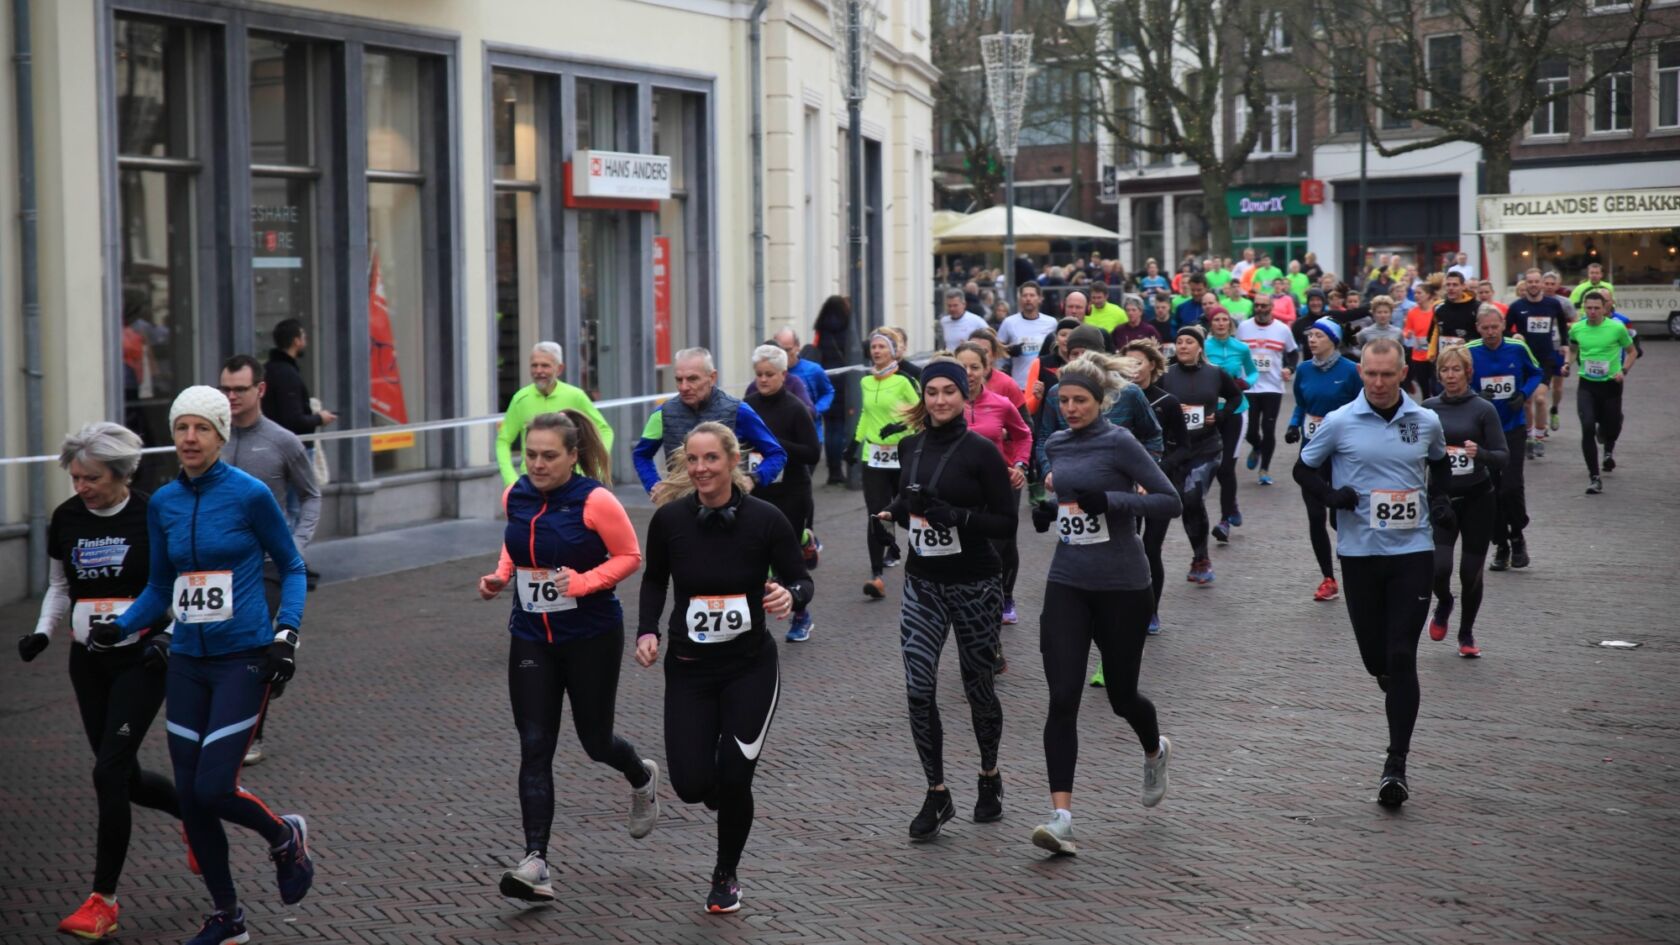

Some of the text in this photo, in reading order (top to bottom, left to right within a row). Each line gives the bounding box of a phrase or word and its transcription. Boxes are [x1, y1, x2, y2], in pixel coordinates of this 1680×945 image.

[604, 159, 668, 181] HANS ANDERS
[1503, 197, 1598, 216] HOLLANDSE
[1530, 321, 1548, 330] 262
[873, 451, 899, 462] 424
[1376, 502, 1417, 520] 825
[1060, 514, 1101, 536] 393
[77, 536, 127, 548] Finisher
[911, 527, 954, 547] 788
[77, 566, 123, 580] 2017
[178, 587, 225, 612] 448
[528, 581, 559, 603] 76
[693, 610, 744, 633] 279
